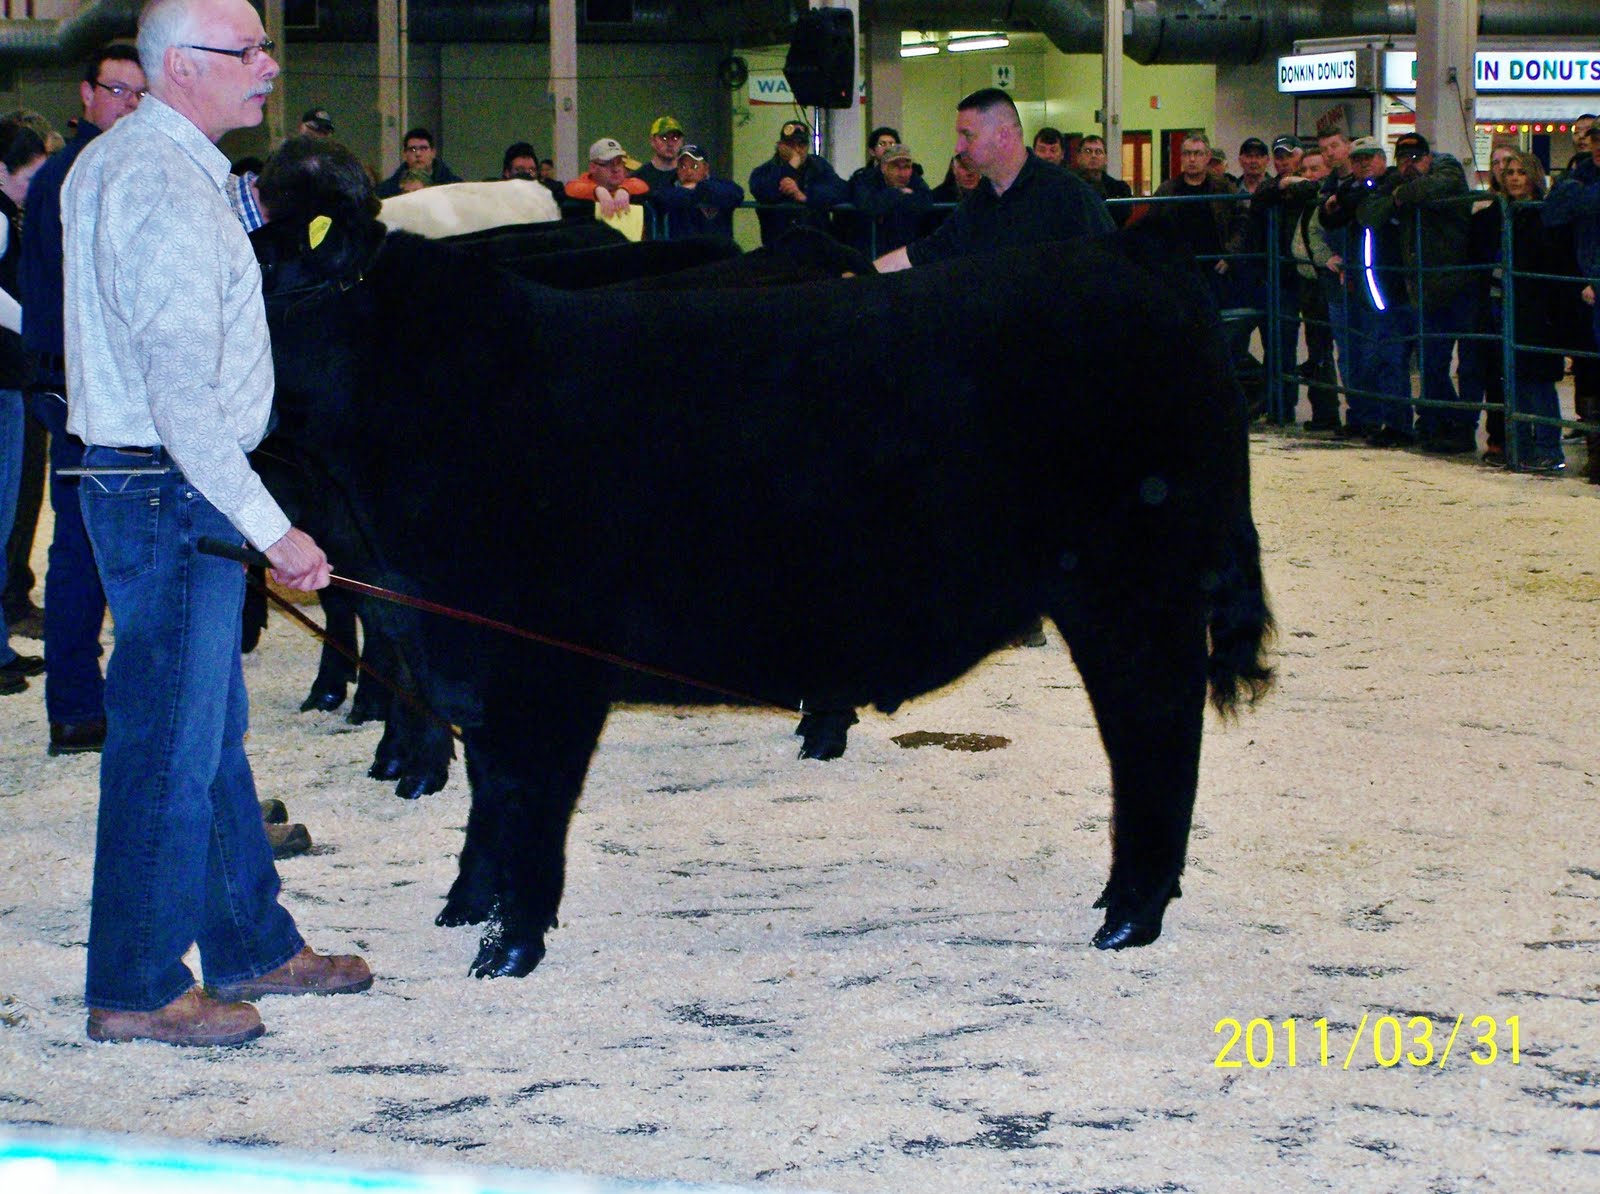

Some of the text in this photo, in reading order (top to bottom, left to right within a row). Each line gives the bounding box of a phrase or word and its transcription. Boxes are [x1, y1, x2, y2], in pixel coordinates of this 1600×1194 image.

[1281, 60, 1355, 83] DONKIN DONUTS
[1509, 60, 1600, 80] DONUTS
